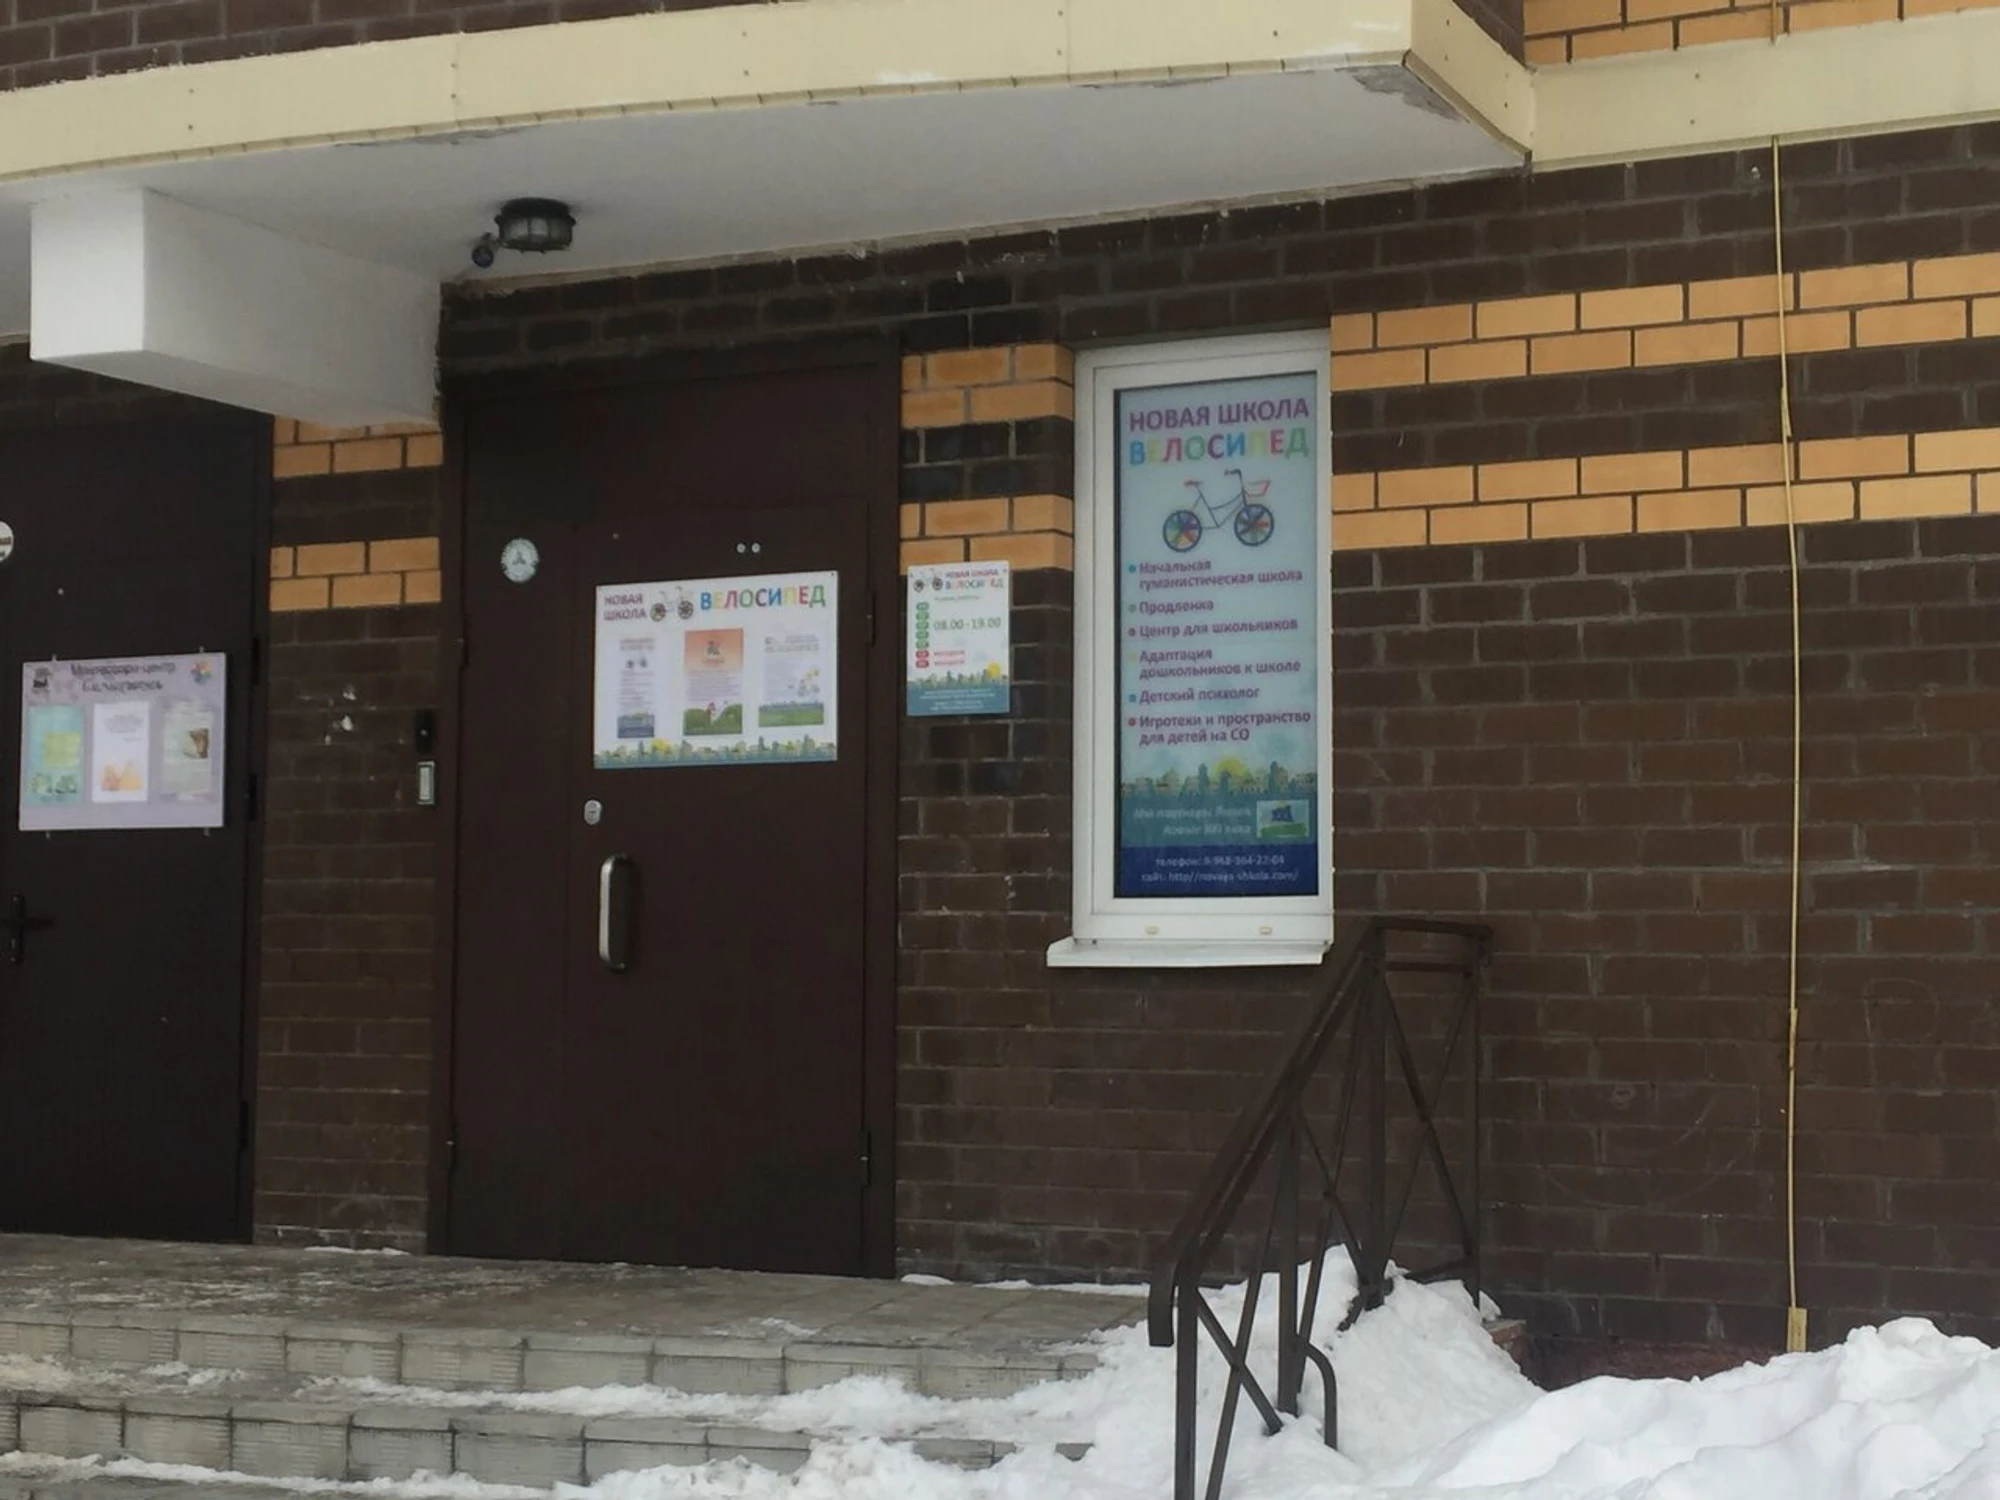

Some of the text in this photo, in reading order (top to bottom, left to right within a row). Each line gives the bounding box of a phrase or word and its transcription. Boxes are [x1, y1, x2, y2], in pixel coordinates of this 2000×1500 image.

[1130, 398, 1309, 432] НОВАЯ ШКОЛА
[1129, 427, 1309, 465] ВЕЛОСИПЕД
[1139, 560, 1211, 574] Начальная
[1139, 570, 1303, 592] гуманистическая школа
[604, 593, 643, 606] НОВАЯ
[700, 585, 826, 611] ВЕЛОСИПЕД
[604, 607, 648, 621] ШКОЛА
[1139, 600, 1214, 616] Продленка
[1140, 618, 1298, 639] Центр для школьников
[1139, 649, 1213, 665] Адаптация
[1139, 660, 1301, 680] дошкольников к школе
[1139, 687, 1260, 705] Детский психолог
[1139, 711, 1311, 730] Игротеки и пространство
[1139, 728, 1250, 747] для детей на СО
